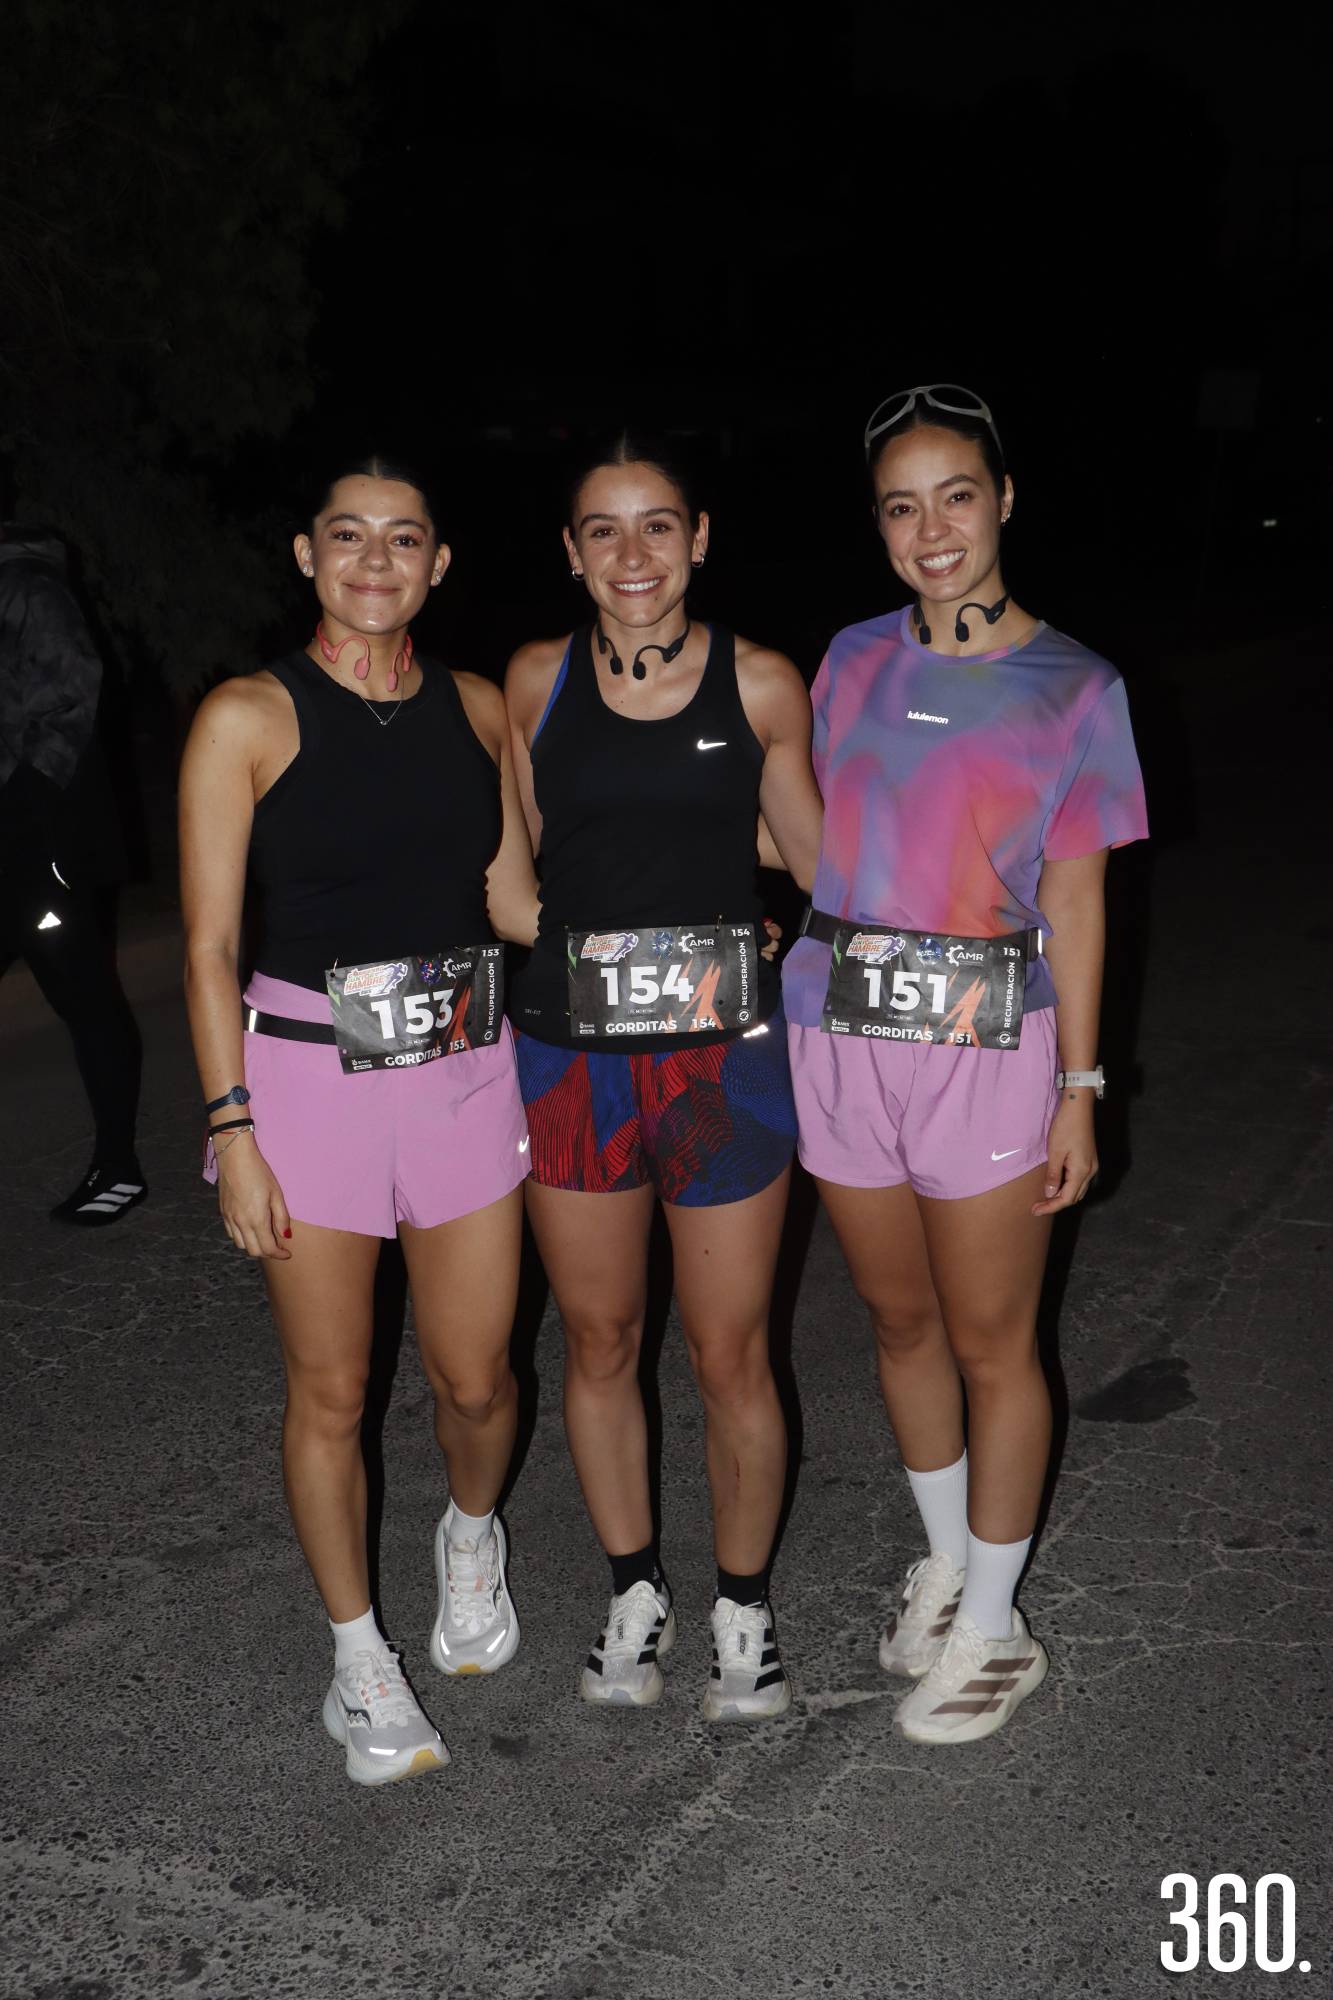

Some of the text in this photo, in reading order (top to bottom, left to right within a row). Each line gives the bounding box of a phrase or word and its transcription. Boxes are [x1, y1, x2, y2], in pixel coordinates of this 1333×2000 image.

[907, 710, 949, 724] lululemon
[731, 928, 751, 937] 154
[689, 938, 715, 947] AMR
[849, 944, 881, 953] HAMBRE
[482, 948, 500, 957] 153
[957, 951, 984, 961] AMR
[451, 961, 472, 972] AMR
[739, 942, 747, 1006] RECUPERACIÓN
[600, 964, 694, 1006] 154
[863, 968, 948, 1014] 151
[1004, 962, 1015, 1028] RECUPERACIÓN
[370, 989, 455, 1040] 153
[605, 1018, 717, 1034] GORDITAS 154
[862, 1024, 972, 1044] GORDITAS 151
[384, 1046, 442, 1067] GORDITAS
[450, 1039, 465, 1052] 153
